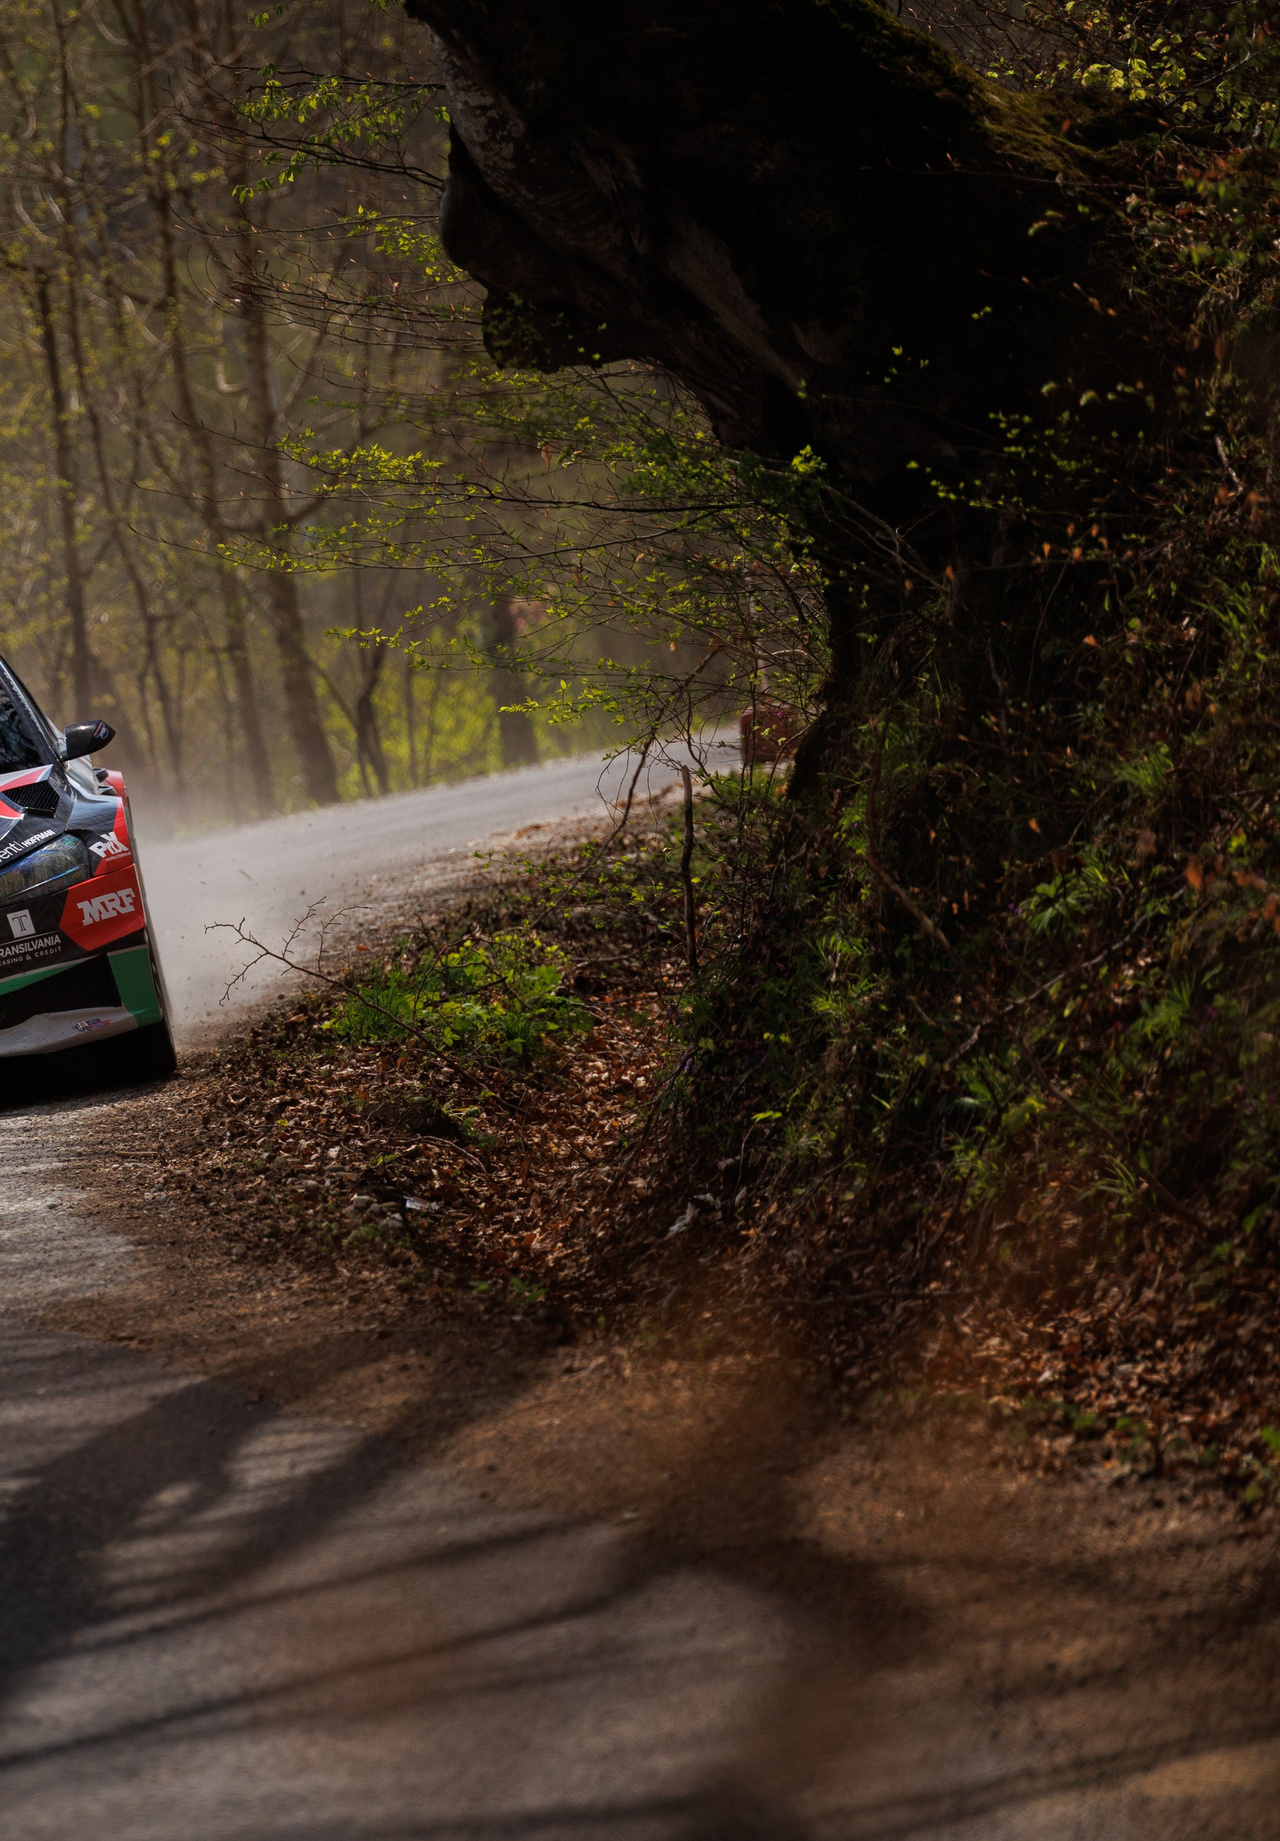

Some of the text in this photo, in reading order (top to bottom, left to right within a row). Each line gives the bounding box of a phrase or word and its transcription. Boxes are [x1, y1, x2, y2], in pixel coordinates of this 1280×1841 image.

[22, 829, 56, 848] HOFFMAN
[76, 888, 136, 926] MRF
[34, 946, 62, 958] CREDIT
